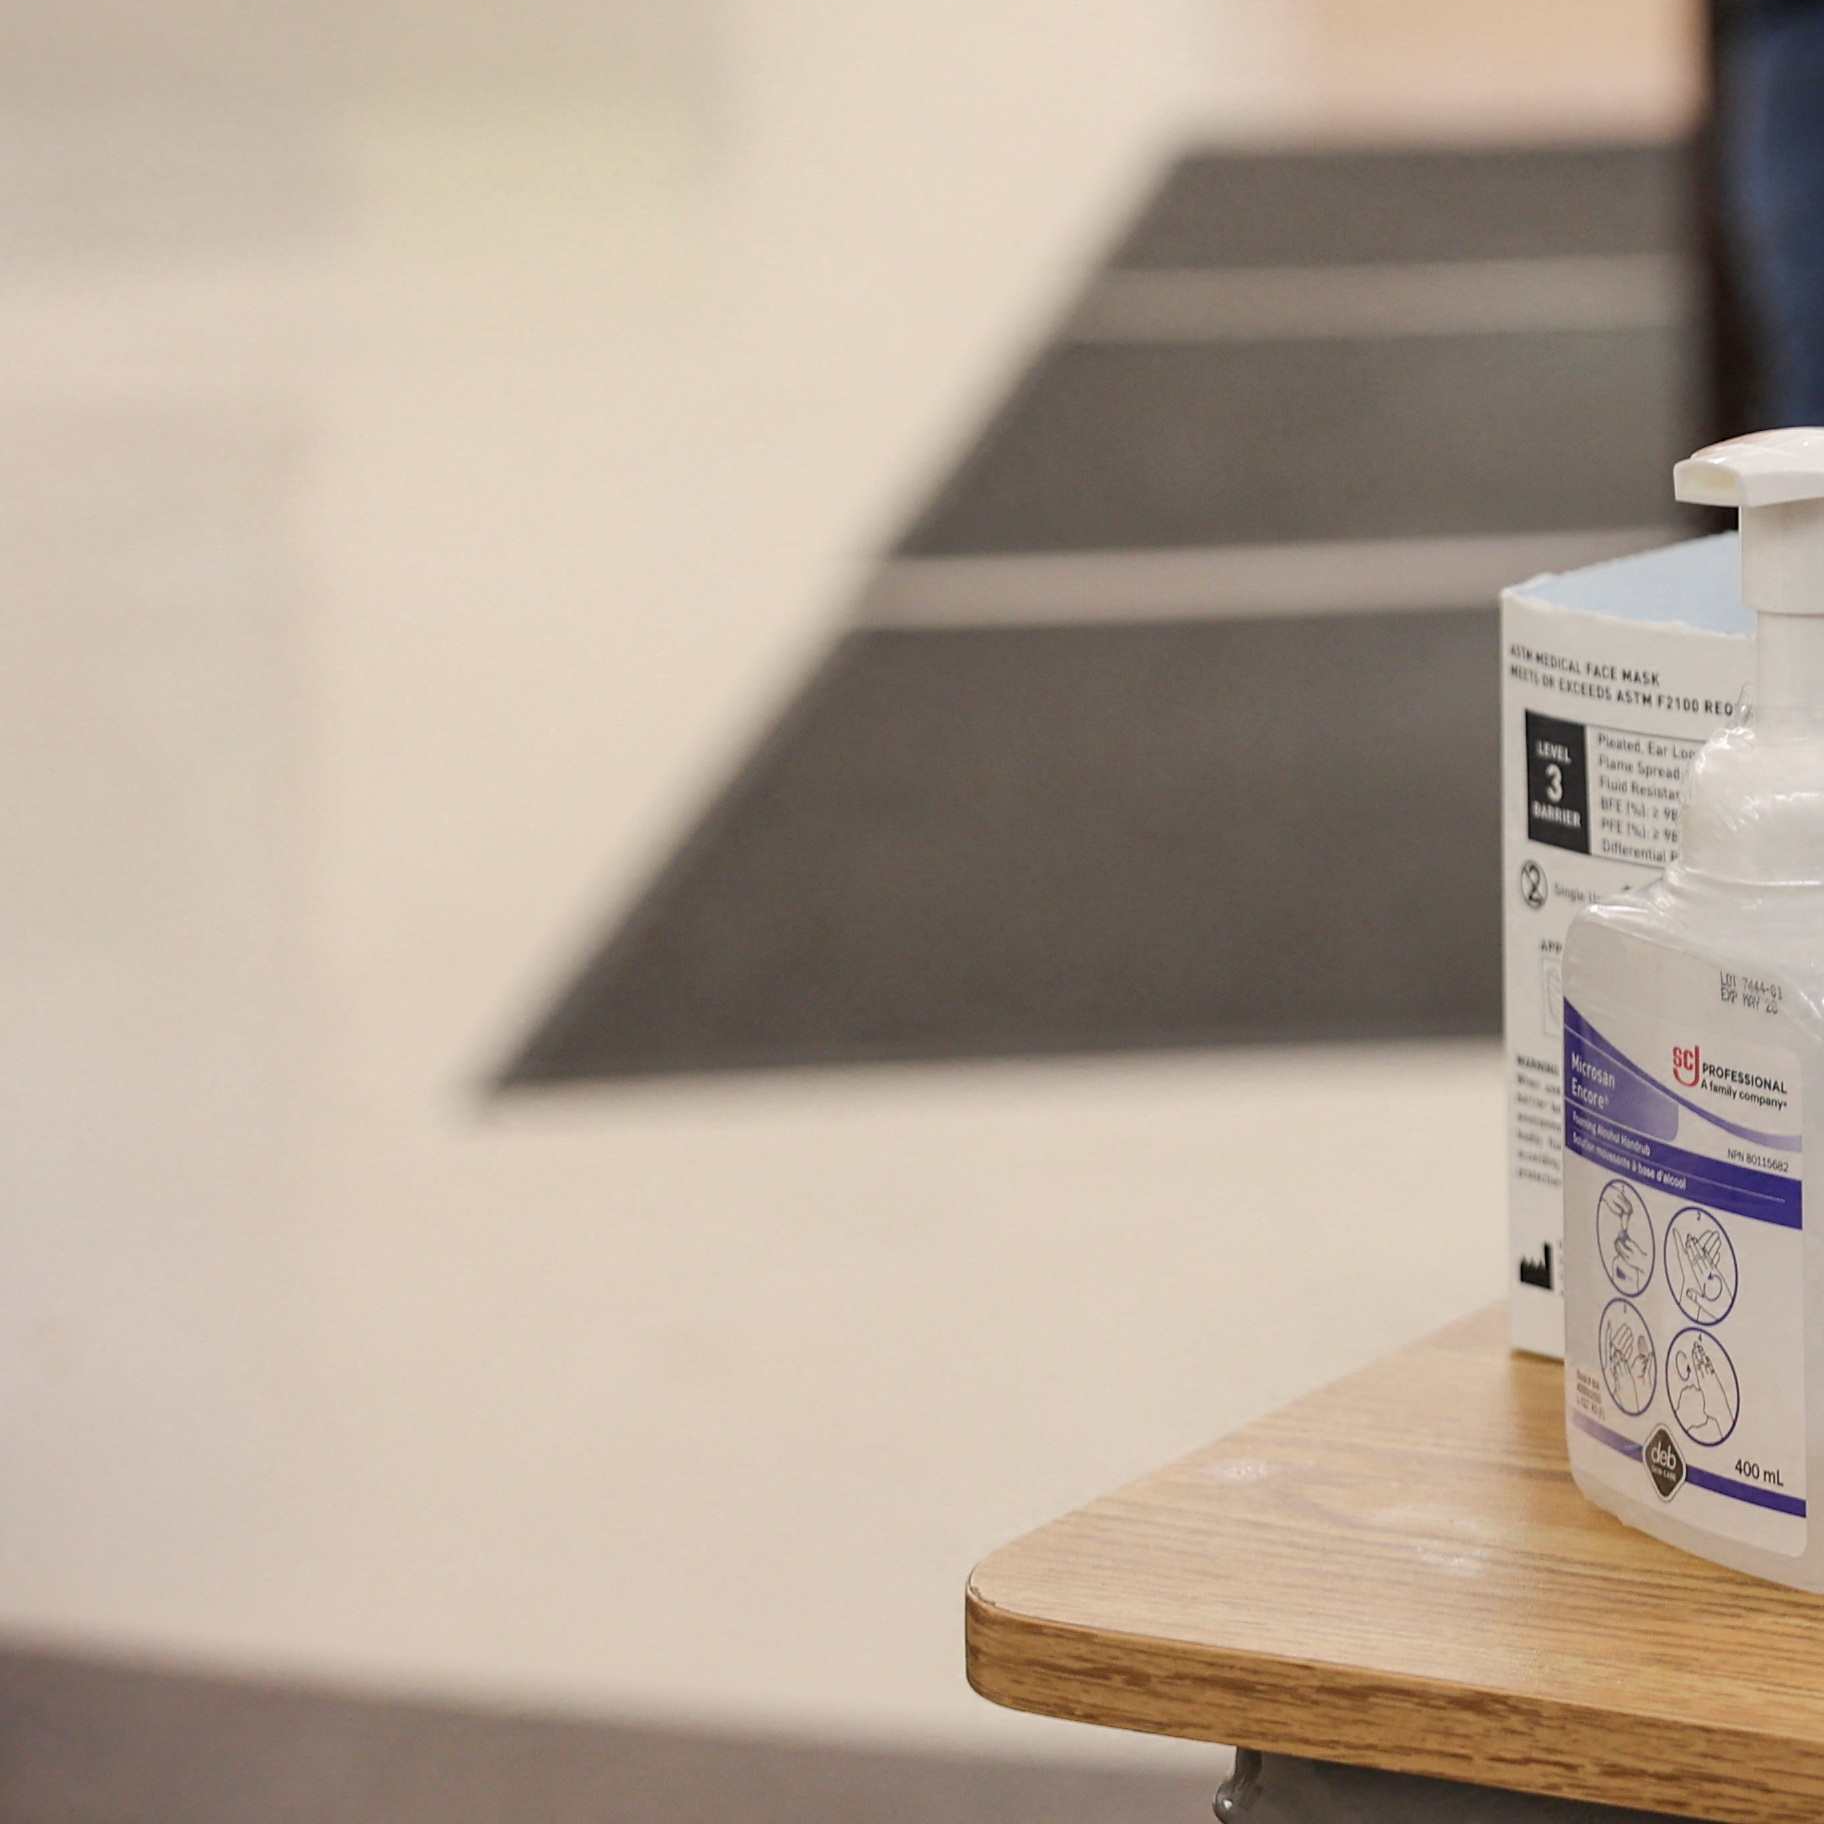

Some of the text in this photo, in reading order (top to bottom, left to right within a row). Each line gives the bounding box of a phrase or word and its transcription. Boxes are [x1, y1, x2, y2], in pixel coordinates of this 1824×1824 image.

[1510, 642, 1661, 687] ASTM MEDICAL FACE MASK
[1510, 664, 1540, 685] MEETS
[1542, 674, 1556, 689] OR
[1559, 677, 1613, 701] EXCEEDS
[1616, 689, 1652, 707] ASTM
[1657, 694, 1700, 713] F2100
[1535, 740, 1572, 764] LEVEL
[1545, 762, 1563, 803] 3
[1531, 800, 1582, 829] BARRIER
[1571, 1051, 1616, 1091] Microsan
[1701, 1061, 1788, 1095] PROFESSIONAL
[1700, 1078, 1709, 1091] A
[1709, 1080, 1738, 1101] family
[1727, 1146, 1746, 1163] NPN
[1651, 1440, 1678, 1471] deb
[1734, 1457, 1785, 1488] 400 mL
